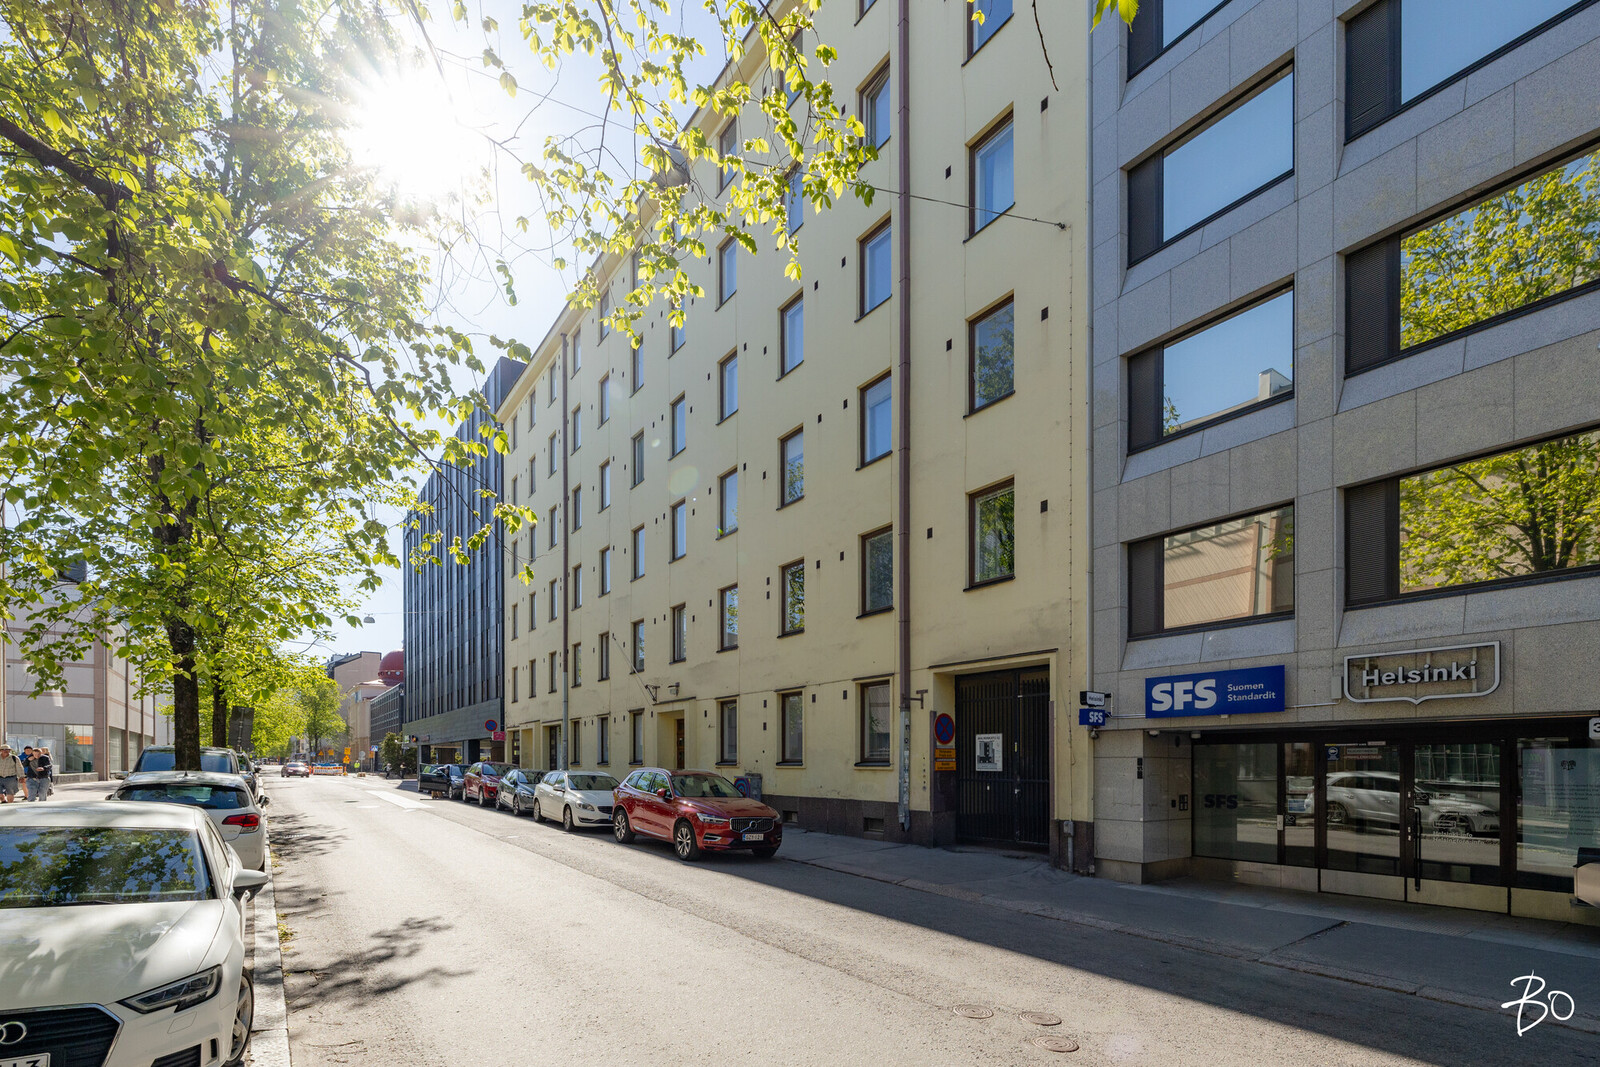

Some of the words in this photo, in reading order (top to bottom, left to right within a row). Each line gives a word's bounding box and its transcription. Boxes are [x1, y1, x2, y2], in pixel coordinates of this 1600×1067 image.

[1362, 661, 1477, 687] Helsinki
[1227, 682, 1264, 692] Suomen
[1151, 678, 1218, 712] SFS
[1227, 691, 1276, 702] Standardit
[1088, 711, 1103, 723] SFS
[1204, 794, 1238, 809] SFS
